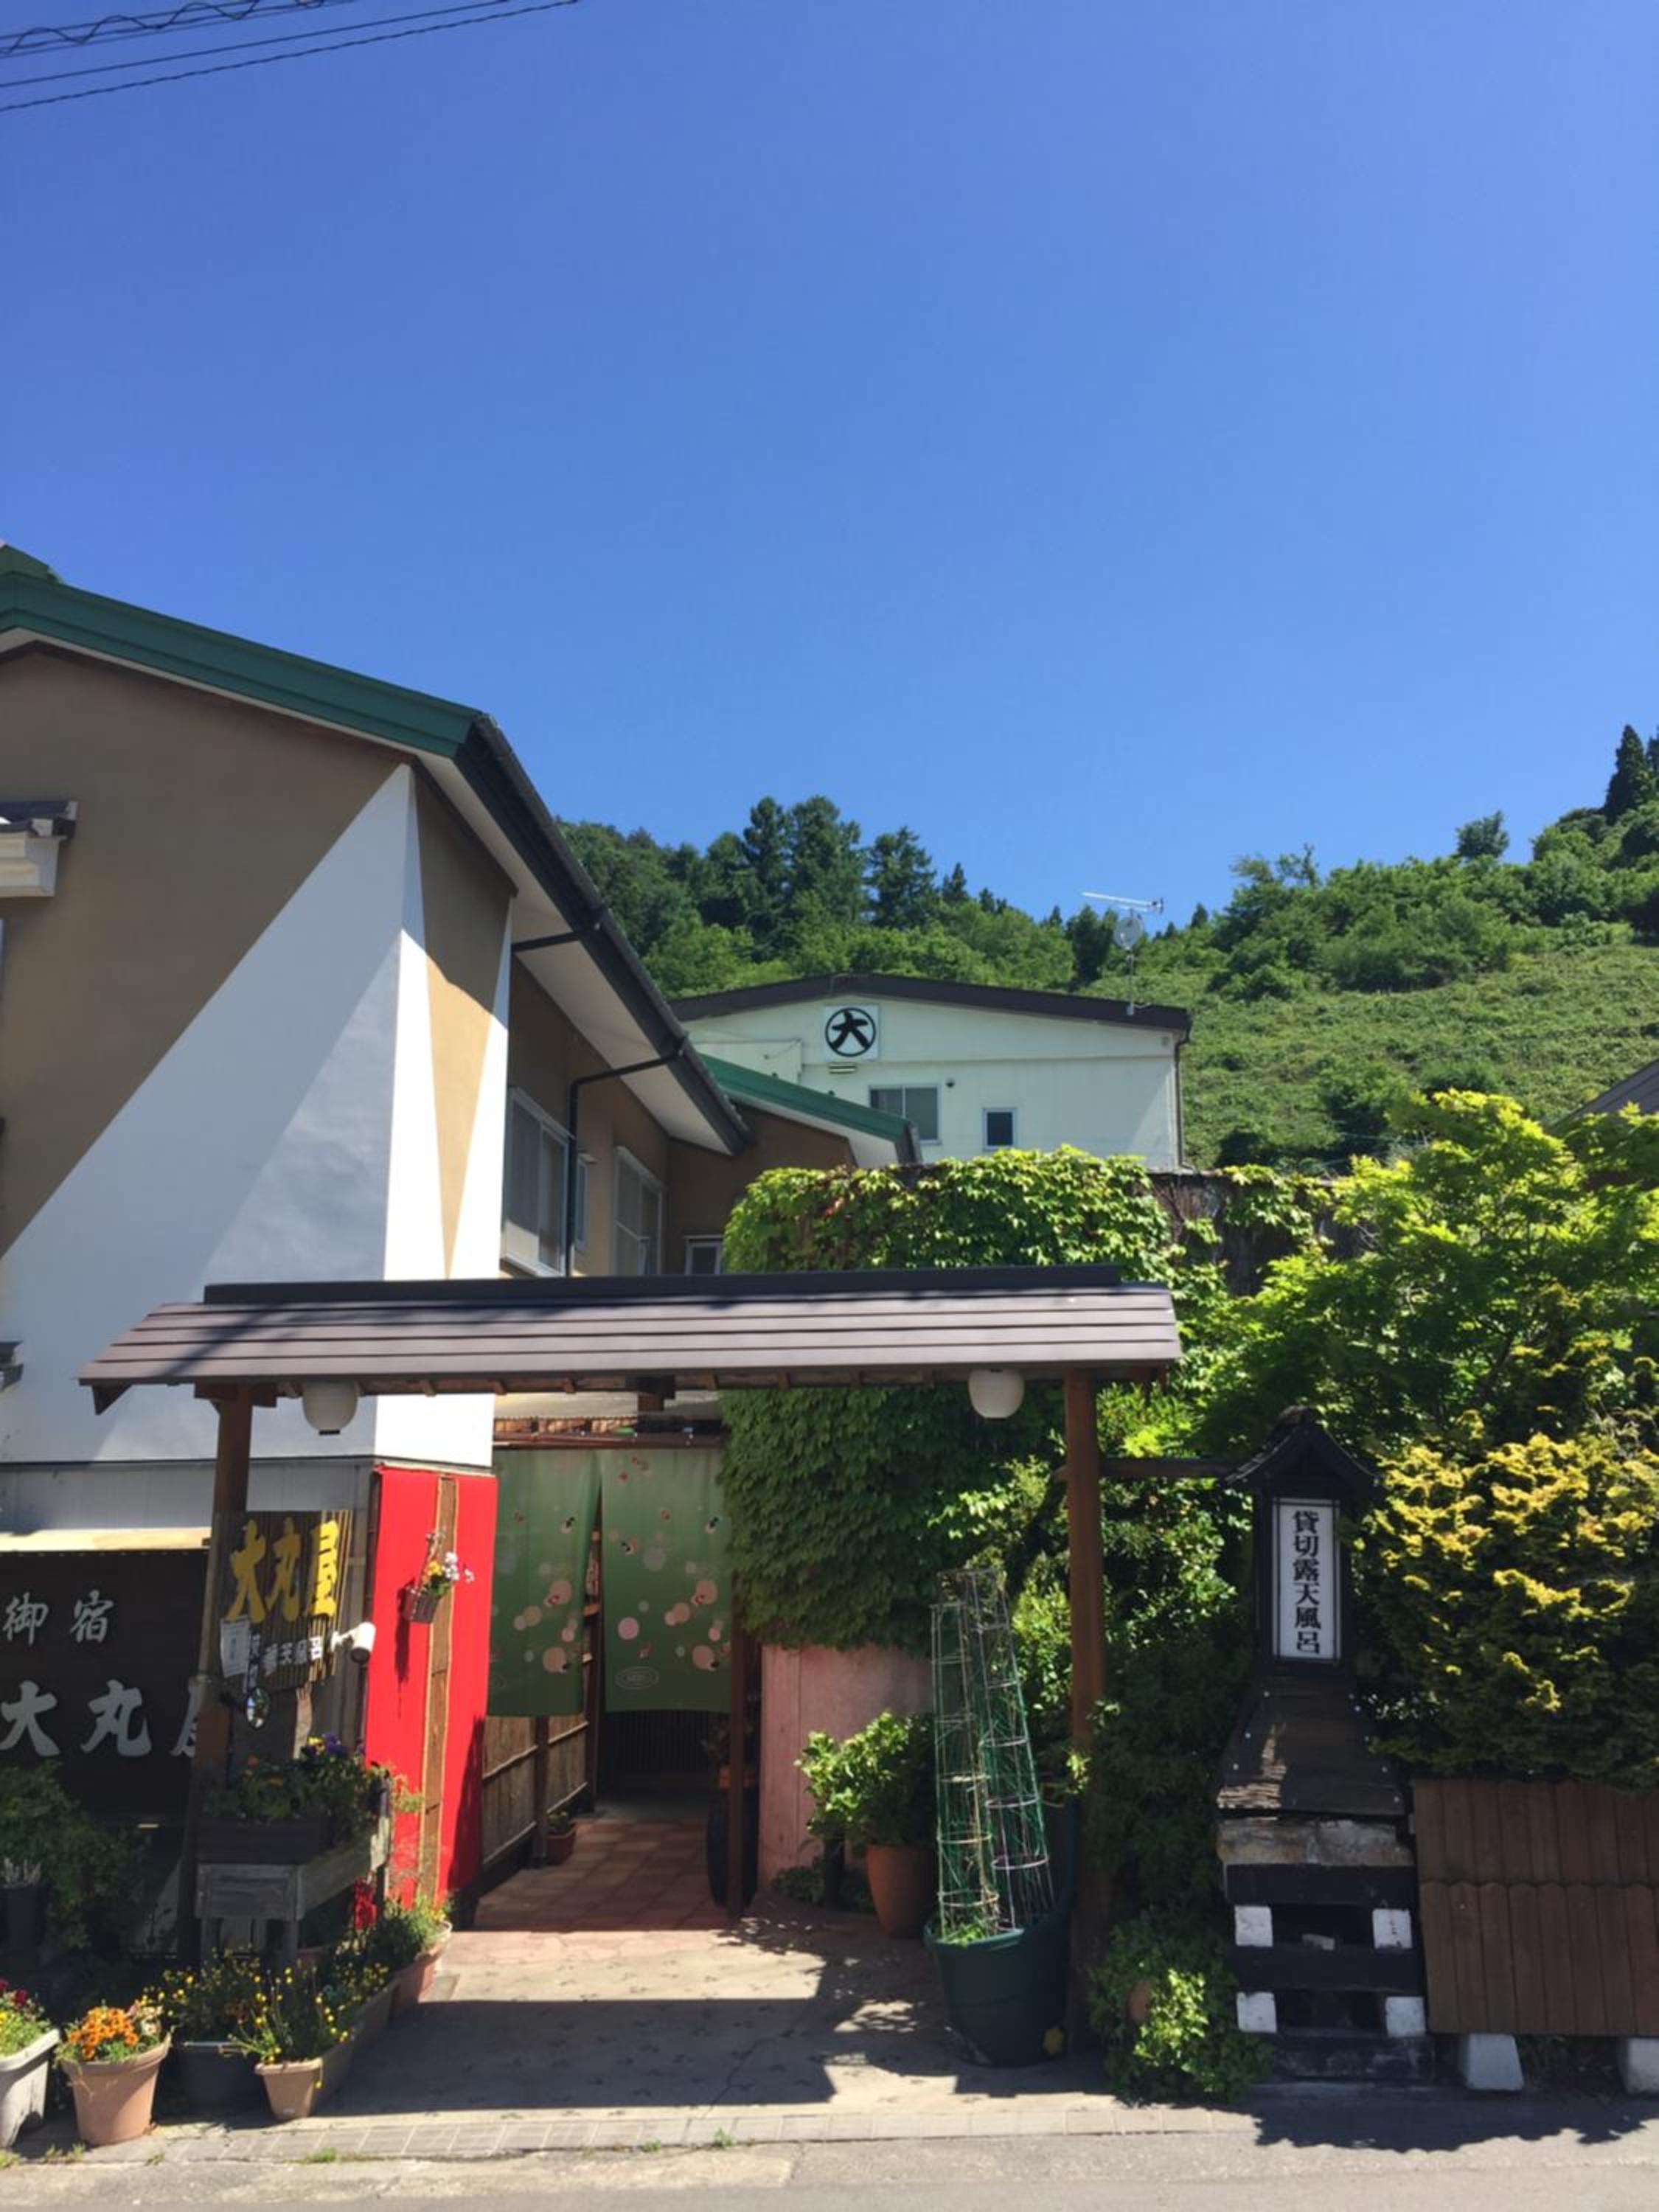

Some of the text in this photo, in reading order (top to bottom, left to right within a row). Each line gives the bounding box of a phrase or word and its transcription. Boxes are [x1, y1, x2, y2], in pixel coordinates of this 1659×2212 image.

[829, 1008, 872, 1051] 大
[227, 1517, 340, 1623] 大丸屋
[1293, 1510, 1321, 1655] 貸切露天風呂
[2, 1590, 114, 1646] 御宿
